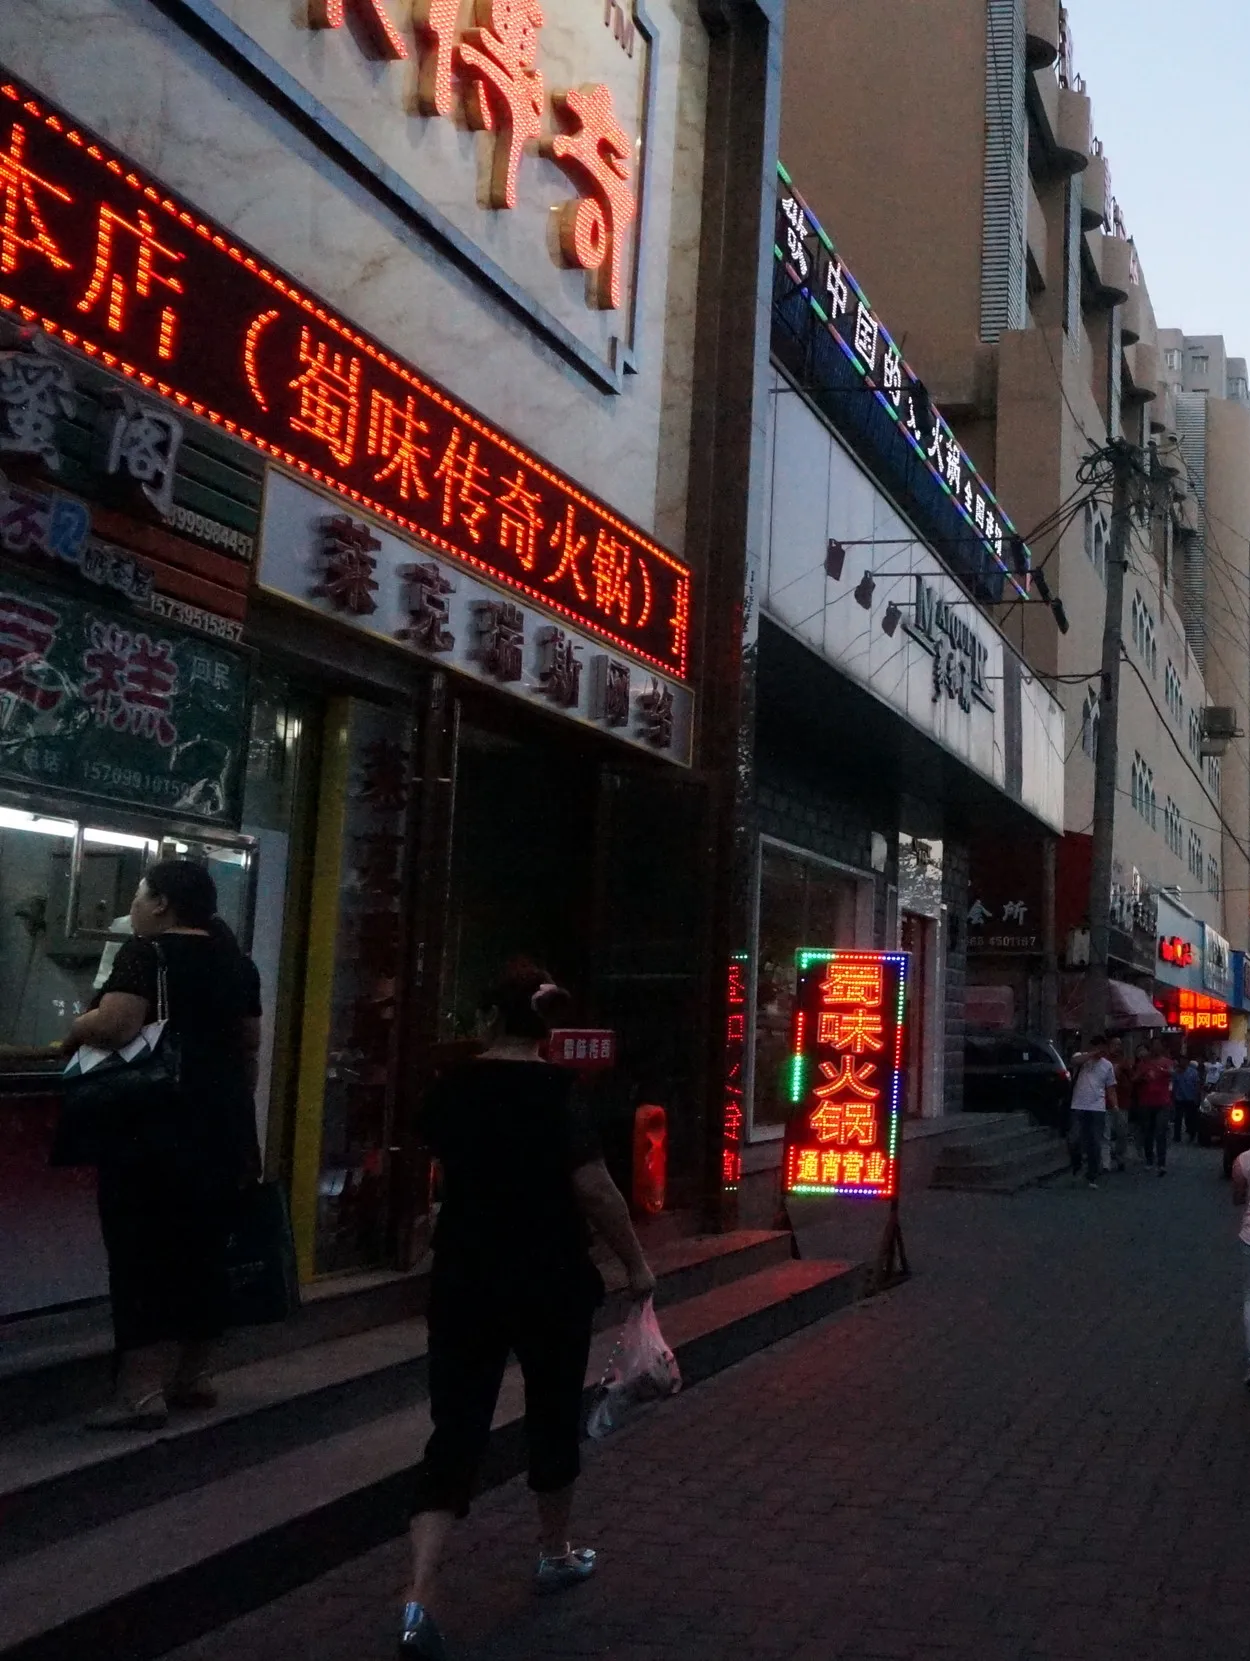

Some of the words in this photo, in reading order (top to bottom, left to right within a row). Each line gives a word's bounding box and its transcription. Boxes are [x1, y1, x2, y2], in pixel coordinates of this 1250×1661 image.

[809, 963, 884, 1147] 蜀味火锅
[797, 1149, 886, 1184] 通宵营业
